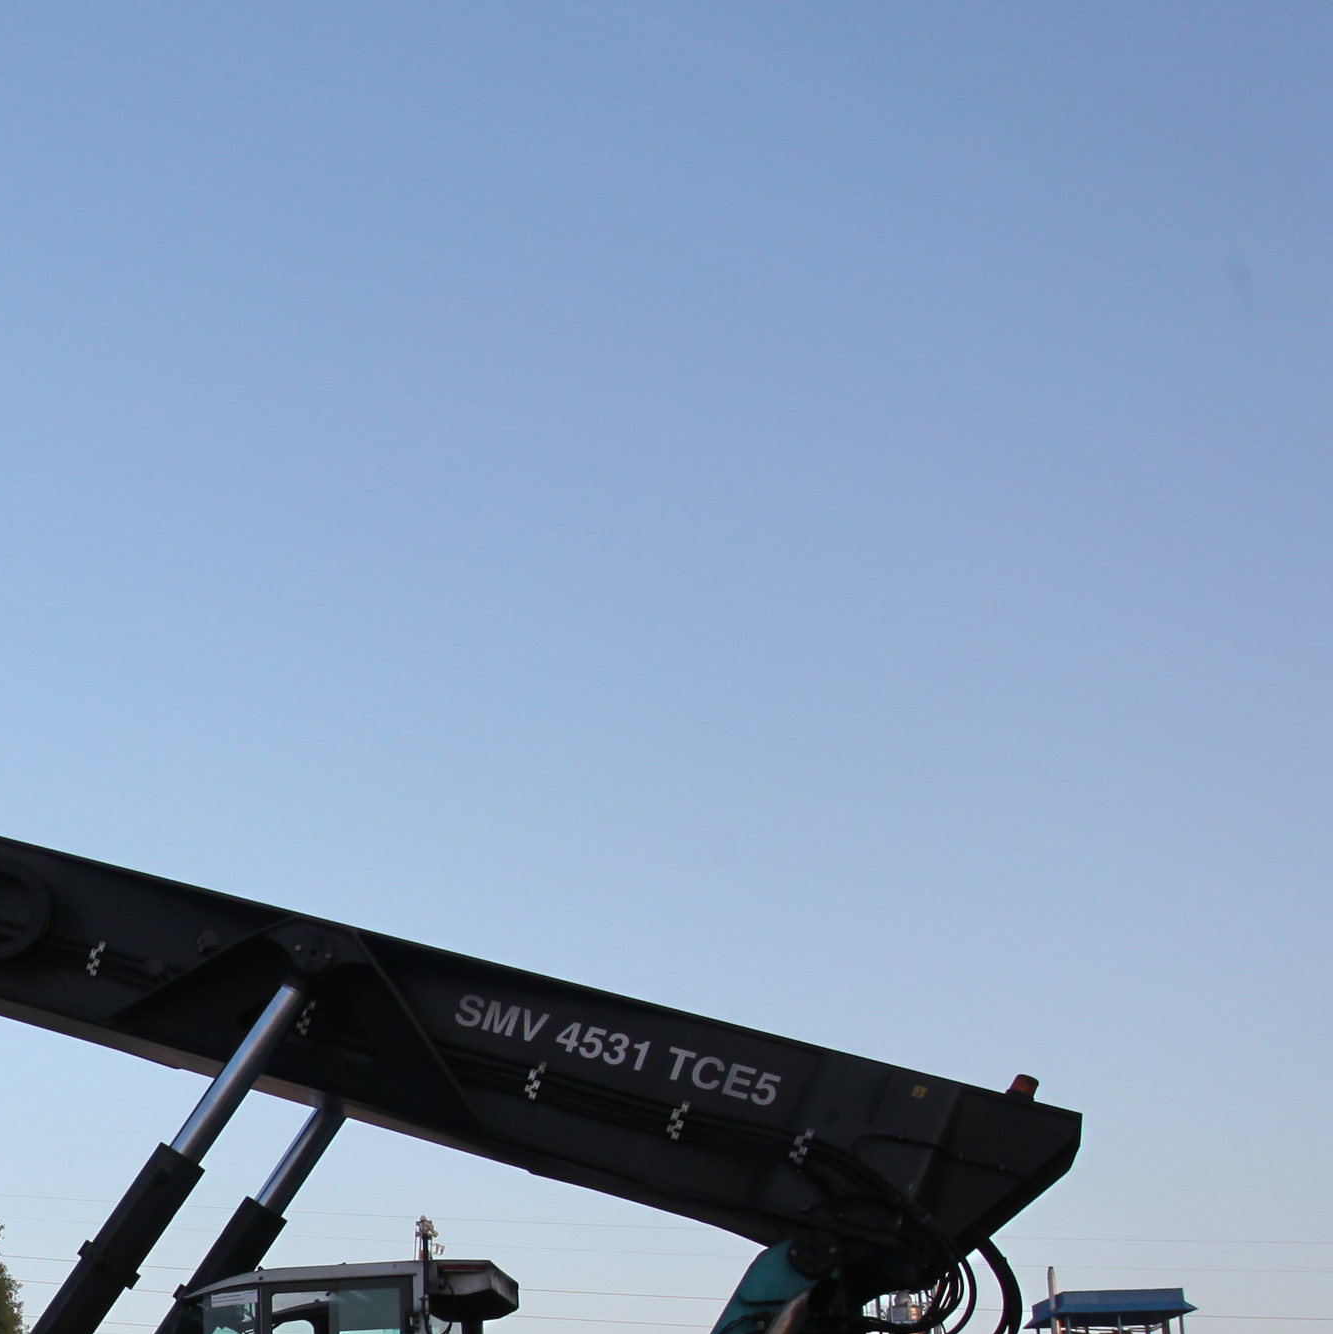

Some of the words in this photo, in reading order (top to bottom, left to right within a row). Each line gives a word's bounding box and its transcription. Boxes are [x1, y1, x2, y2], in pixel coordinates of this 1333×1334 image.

[455, 995, 550, 1042] SMV
[556, 1022, 651, 1072] 4531
[669, 1046, 782, 1107] TCE5
